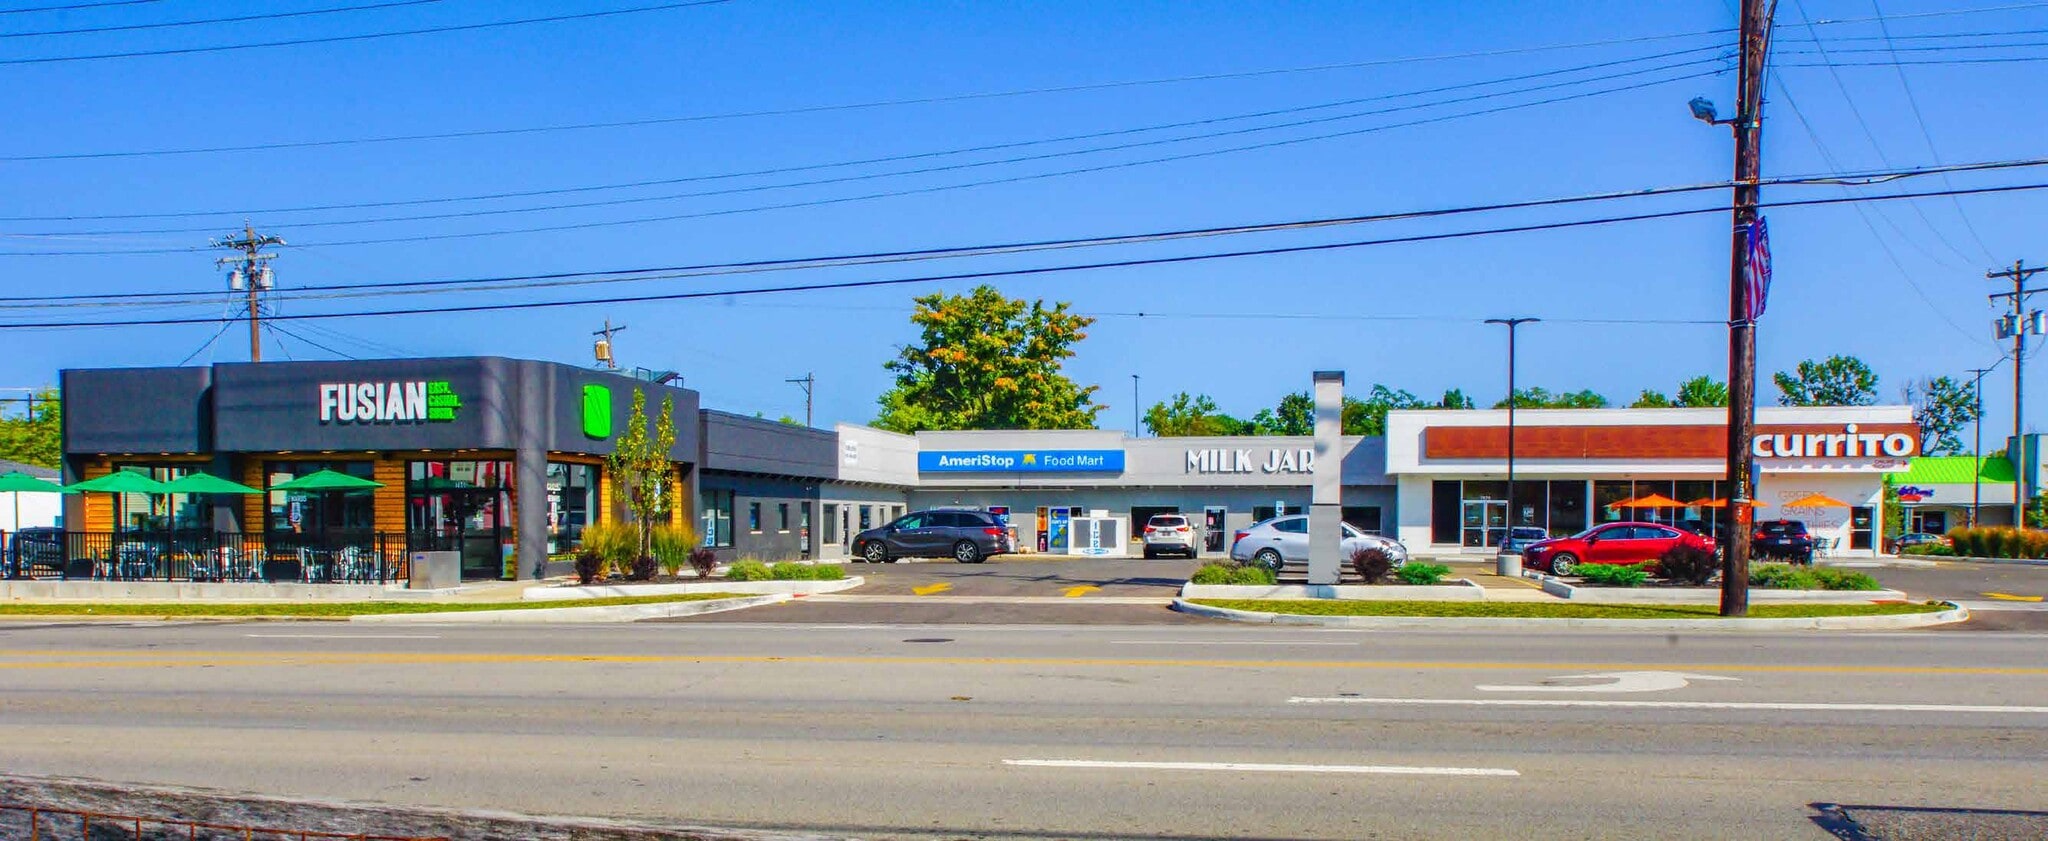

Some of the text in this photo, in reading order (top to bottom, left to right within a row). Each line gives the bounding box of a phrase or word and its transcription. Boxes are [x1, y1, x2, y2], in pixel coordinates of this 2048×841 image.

[319, 381, 428, 421] FUSIAN
[1752, 423, 1915, 457] currito
[938, 454, 1105, 469] AmeriStop Food Mart
[1186, 448, 1315, 473] MILK JAR
